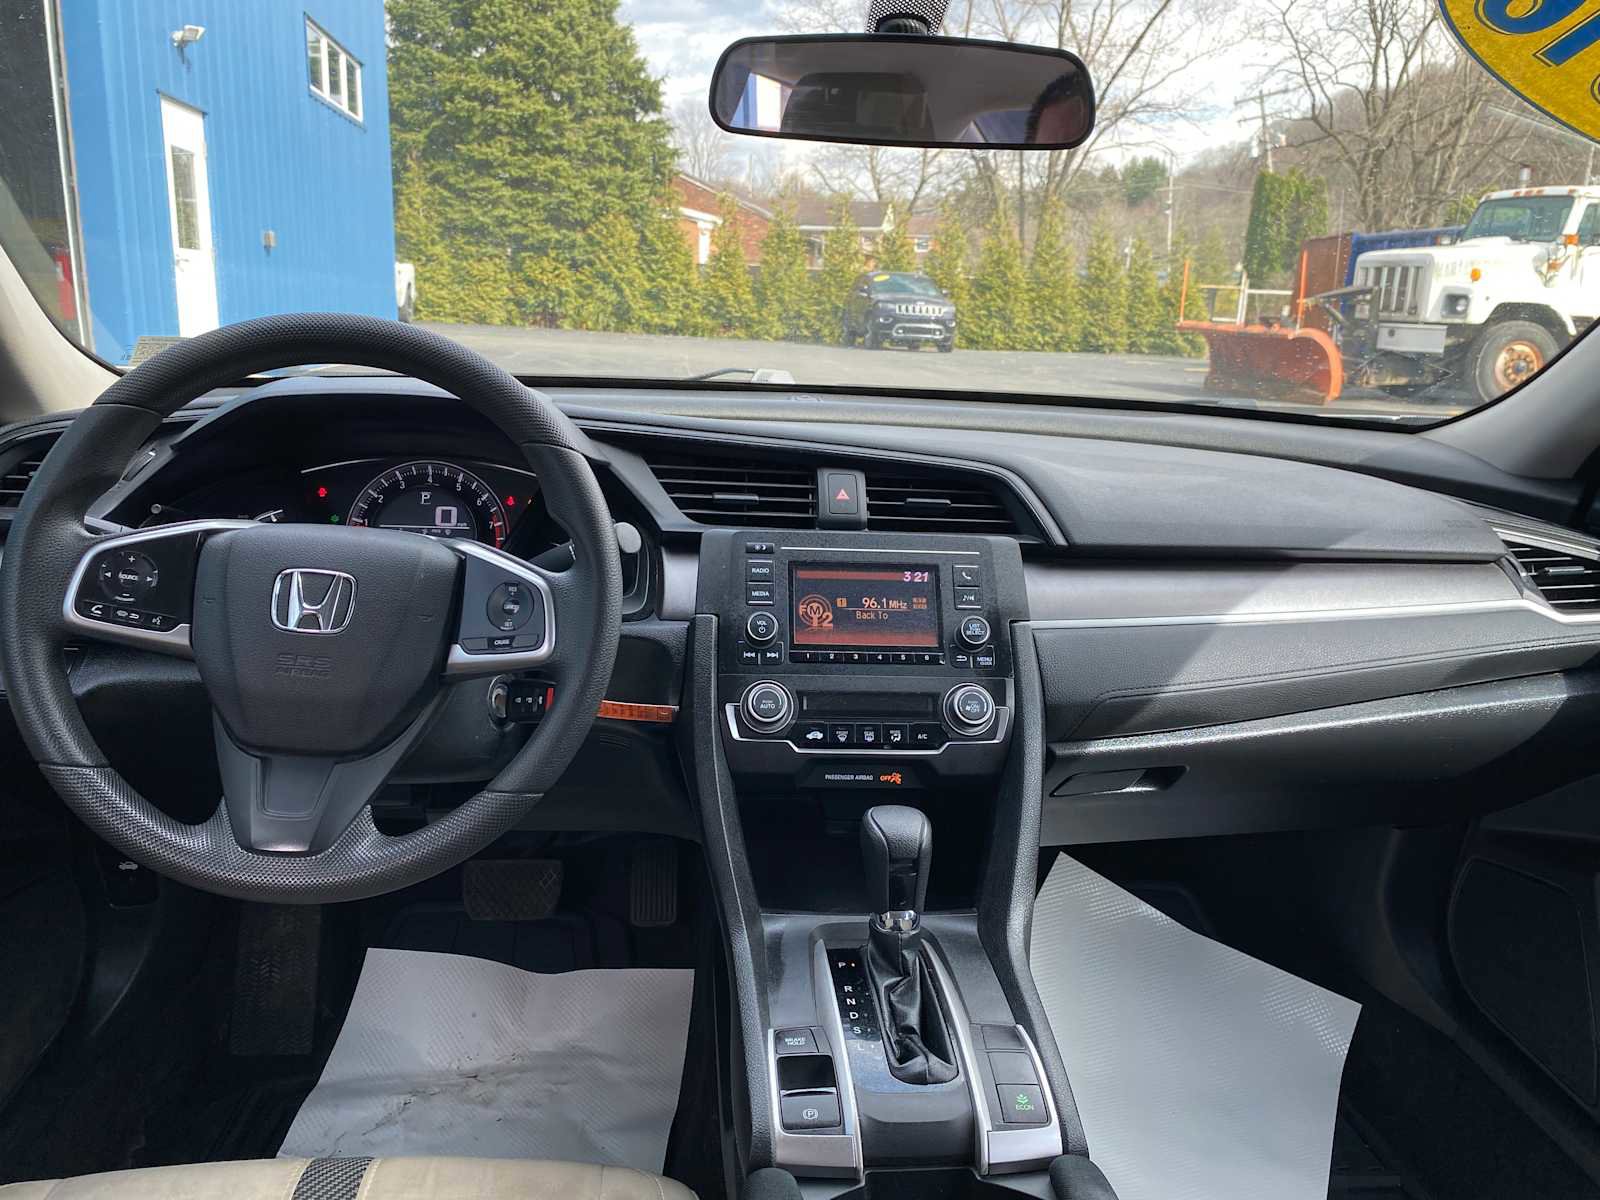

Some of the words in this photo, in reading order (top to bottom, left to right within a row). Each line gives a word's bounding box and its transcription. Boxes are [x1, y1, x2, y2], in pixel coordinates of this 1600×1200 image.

[400, 481, 406, 489] 3
[456, 482, 462, 491] 5
[378, 494, 384, 504] 2
[421, 492, 430, 504] P
[476, 497, 483, 506] 6
[435, 506, 457, 526] 0
[862, 597, 887, 609] 96.1
[888, 600, 908, 609] MHz
[855, 610, 875, 620] Back
[879, 610, 889, 620] To
[846, 998, 856, 1006] N
[849, 1011, 859, 1019] D
[853, 1026, 861, 1034] S
